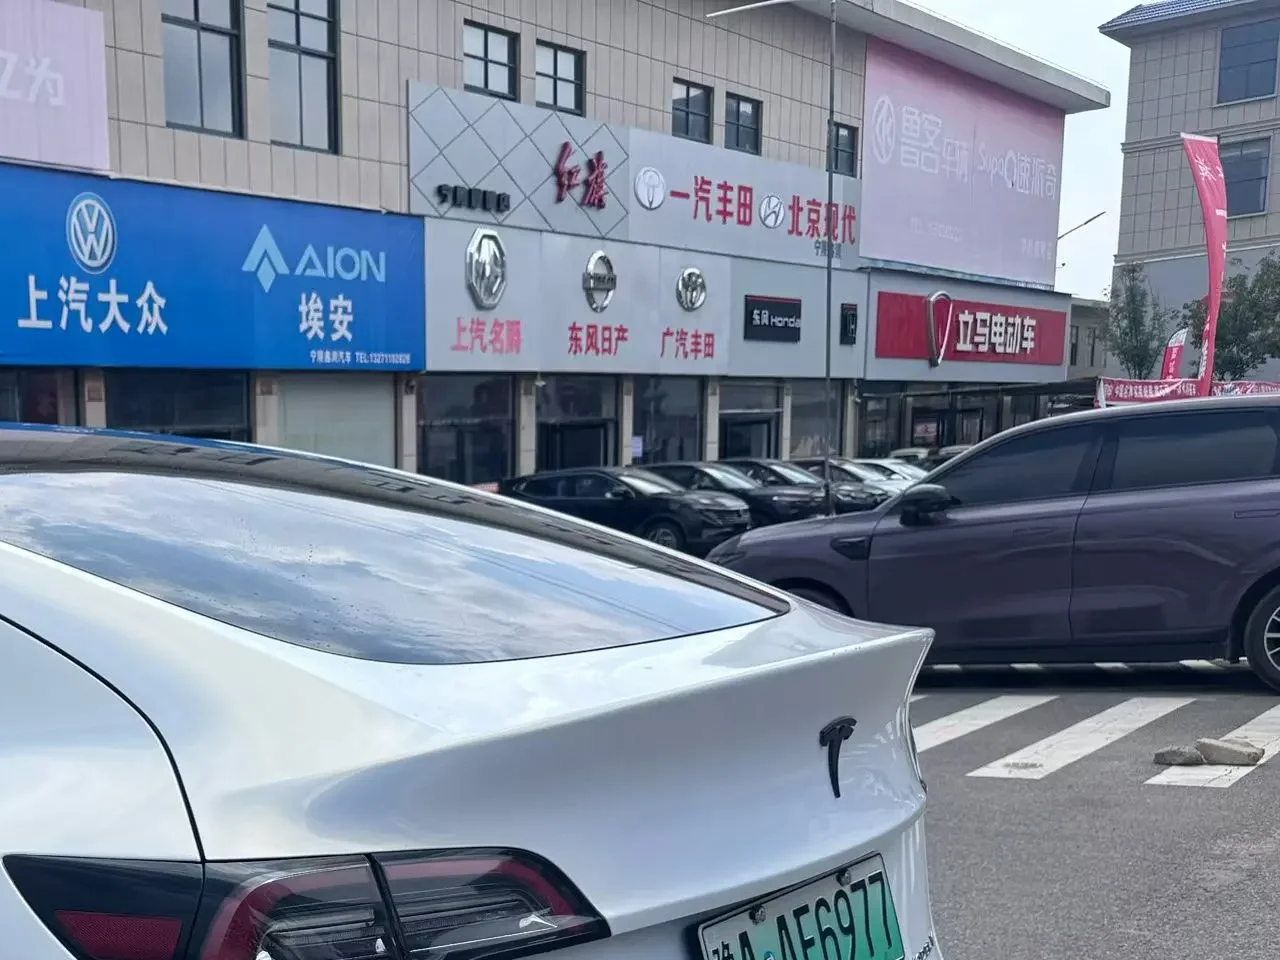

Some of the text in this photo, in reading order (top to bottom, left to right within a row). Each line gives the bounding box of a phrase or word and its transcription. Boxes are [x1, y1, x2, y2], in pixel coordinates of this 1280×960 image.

[553, 141, 609, 210] 红旗
[670, 175, 753, 226] 一汽丰田
[788, 194, 856, 245] 北京现代
[294, 244, 386, 283] AION
[17, 274, 168, 335] 上汽大众
[299, 292, 353, 342] 埃安
[567, 321, 629, 356] 东风日产
[660, 328, 715, 360] 广汽丰田
[956, 310, 1037, 354] 立马电动车
